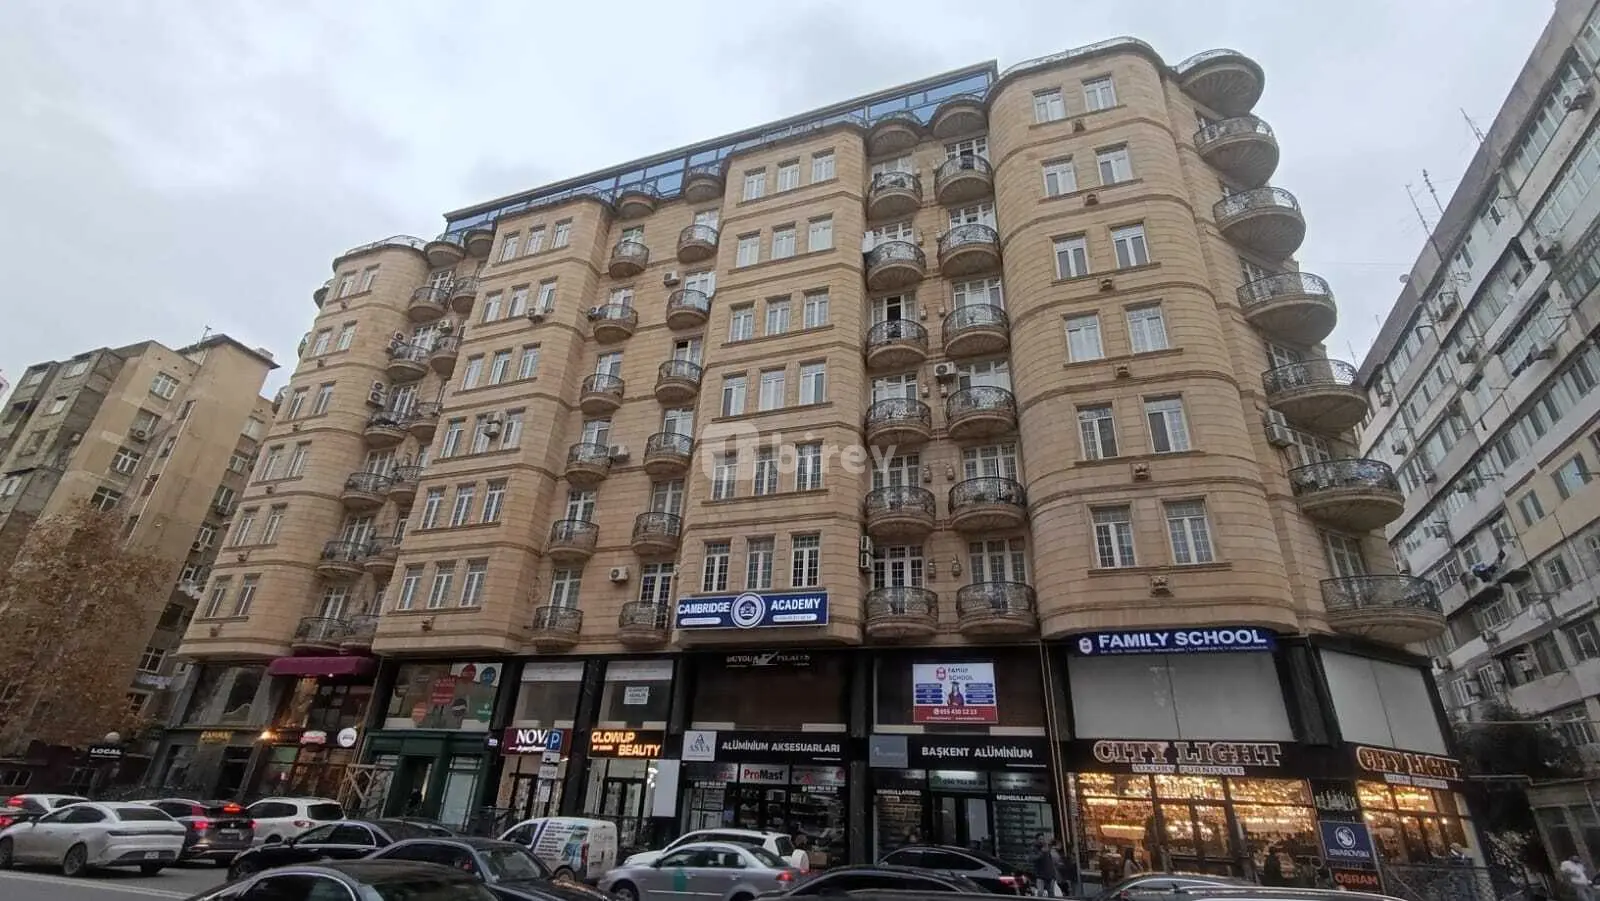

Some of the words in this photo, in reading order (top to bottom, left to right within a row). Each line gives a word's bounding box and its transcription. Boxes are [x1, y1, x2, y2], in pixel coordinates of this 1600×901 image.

[678, 602, 731, 614] CAMBRIDGE
[771, 598, 821, 611] ACADEMY
[1099, 632, 1169, 648] FAMILY
[1174, 629, 1267, 646] SCHOOL
[591, 731, 636, 743] GLOWUP
[90, 747, 122, 756] LOCAL
[618, 744, 661, 756] BEAUTY
[771, 743, 840, 753] AKSESUARLARI
[922, 746, 970, 758] BAŞKENT
[1093, 740, 1169, 764] CITY
[1174, 742, 1281, 767] LIGHT
[1131, 764, 1176, 774] LUXURY
[1179, 764, 1245, 776] FURNITURE
[1356, 746, 1403, 774] CITY
[1403, 752, 1464, 782] LIGHT
[1334, 872, 1378, 885] OSRAM
